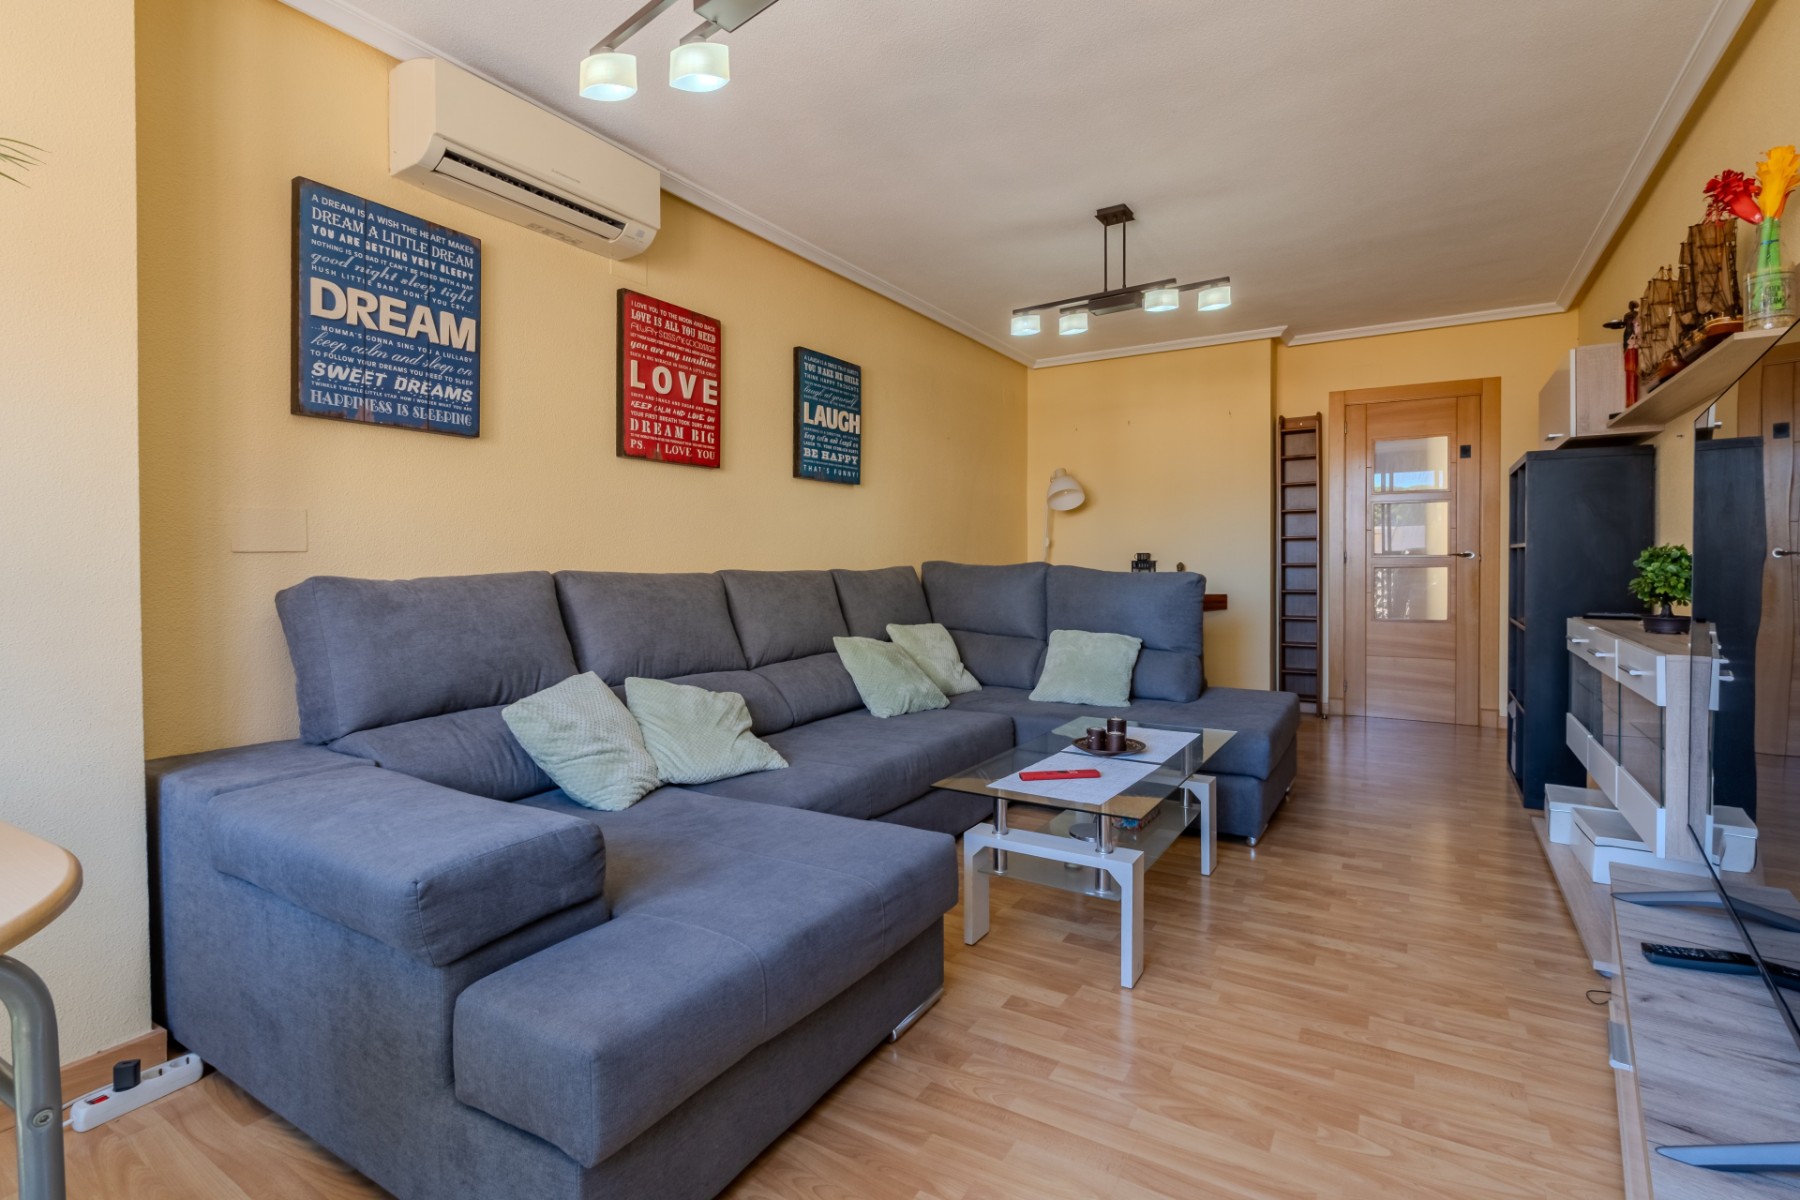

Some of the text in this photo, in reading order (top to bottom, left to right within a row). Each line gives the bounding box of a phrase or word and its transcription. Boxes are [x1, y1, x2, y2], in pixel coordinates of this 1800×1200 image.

[312, 194, 474, 255] A DREAM IS A WISH THE HEART MAKES
[312, 207, 473, 270] DREAM A LITTLE DREAM
[311, 224, 474, 282] YOU ARE GETTING VERY SLEEPY
[311, 239, 343, 253] NOTHING
[366, 255, 379, 264] BAD
[389, 262, 408, 272] CAN'T
[420, 271, 437, 281] FIXED
[440, 277, 454, 286] WITH
[311, 245, 474, 308] good night sleep tight
[312, 265, 336, 277] HUSH
[342, 273, 372, 286] LITTLE
[377, 283, 399, 294] BABY
[404, 290, 428, 301] DON'T
[433, 298, 447, 307] YOU
[310, 277, 476, 352] DREAM
[631, 309, 716, 344] LOVE IS ALL YOU NEED
[635, 302, 647, 310] LOVE
[649, 306, 658, 314] YOU
[668, 312, 678, 321] THE
[311, 330, 473, 378] keep calm and sleep on
[366, 335, 394, 346] GONNA
[397, 342, 414, 351] SING
[443, 352, 473, 363] LULLABY
[631, 341, 716, 370] you are my sunshine
[312, 361, 473, 403] SWEET DREAMS
[324, 352, 354, 363] FOLLOW
[357, 359, 377, 368] YOUR
[379, 364, 408, 373] DREAMS
[455, 378, 474, 386] SLEEP
[630, 359, 718, 406] LOVE
[804, 373, 819, 381] THINK
[311, 390, 472, 427] HAPPINESS IS SLEEPING
[631, 400, 652, 411] KEEP
[654, 405, 671, 414] CALM
[673, 409, 685, 417] AND
[687, 412, 705, 421] LOVE
[659, 416, 677, 424] BREATH
[803, 401, 861, 434] LAUGH
[630, 418, 684, 439] DREAM
[691, 429, 715, 444] BIG
[630, 439, 646, 450] PS.
[656, 443, 660, 452] I
[665, 444, 693, 457] LOVE
[697, 449, 715, 460] YOU
[803, 448, 818, 458] BE
[821, 451, 858, 465] HAPPY
